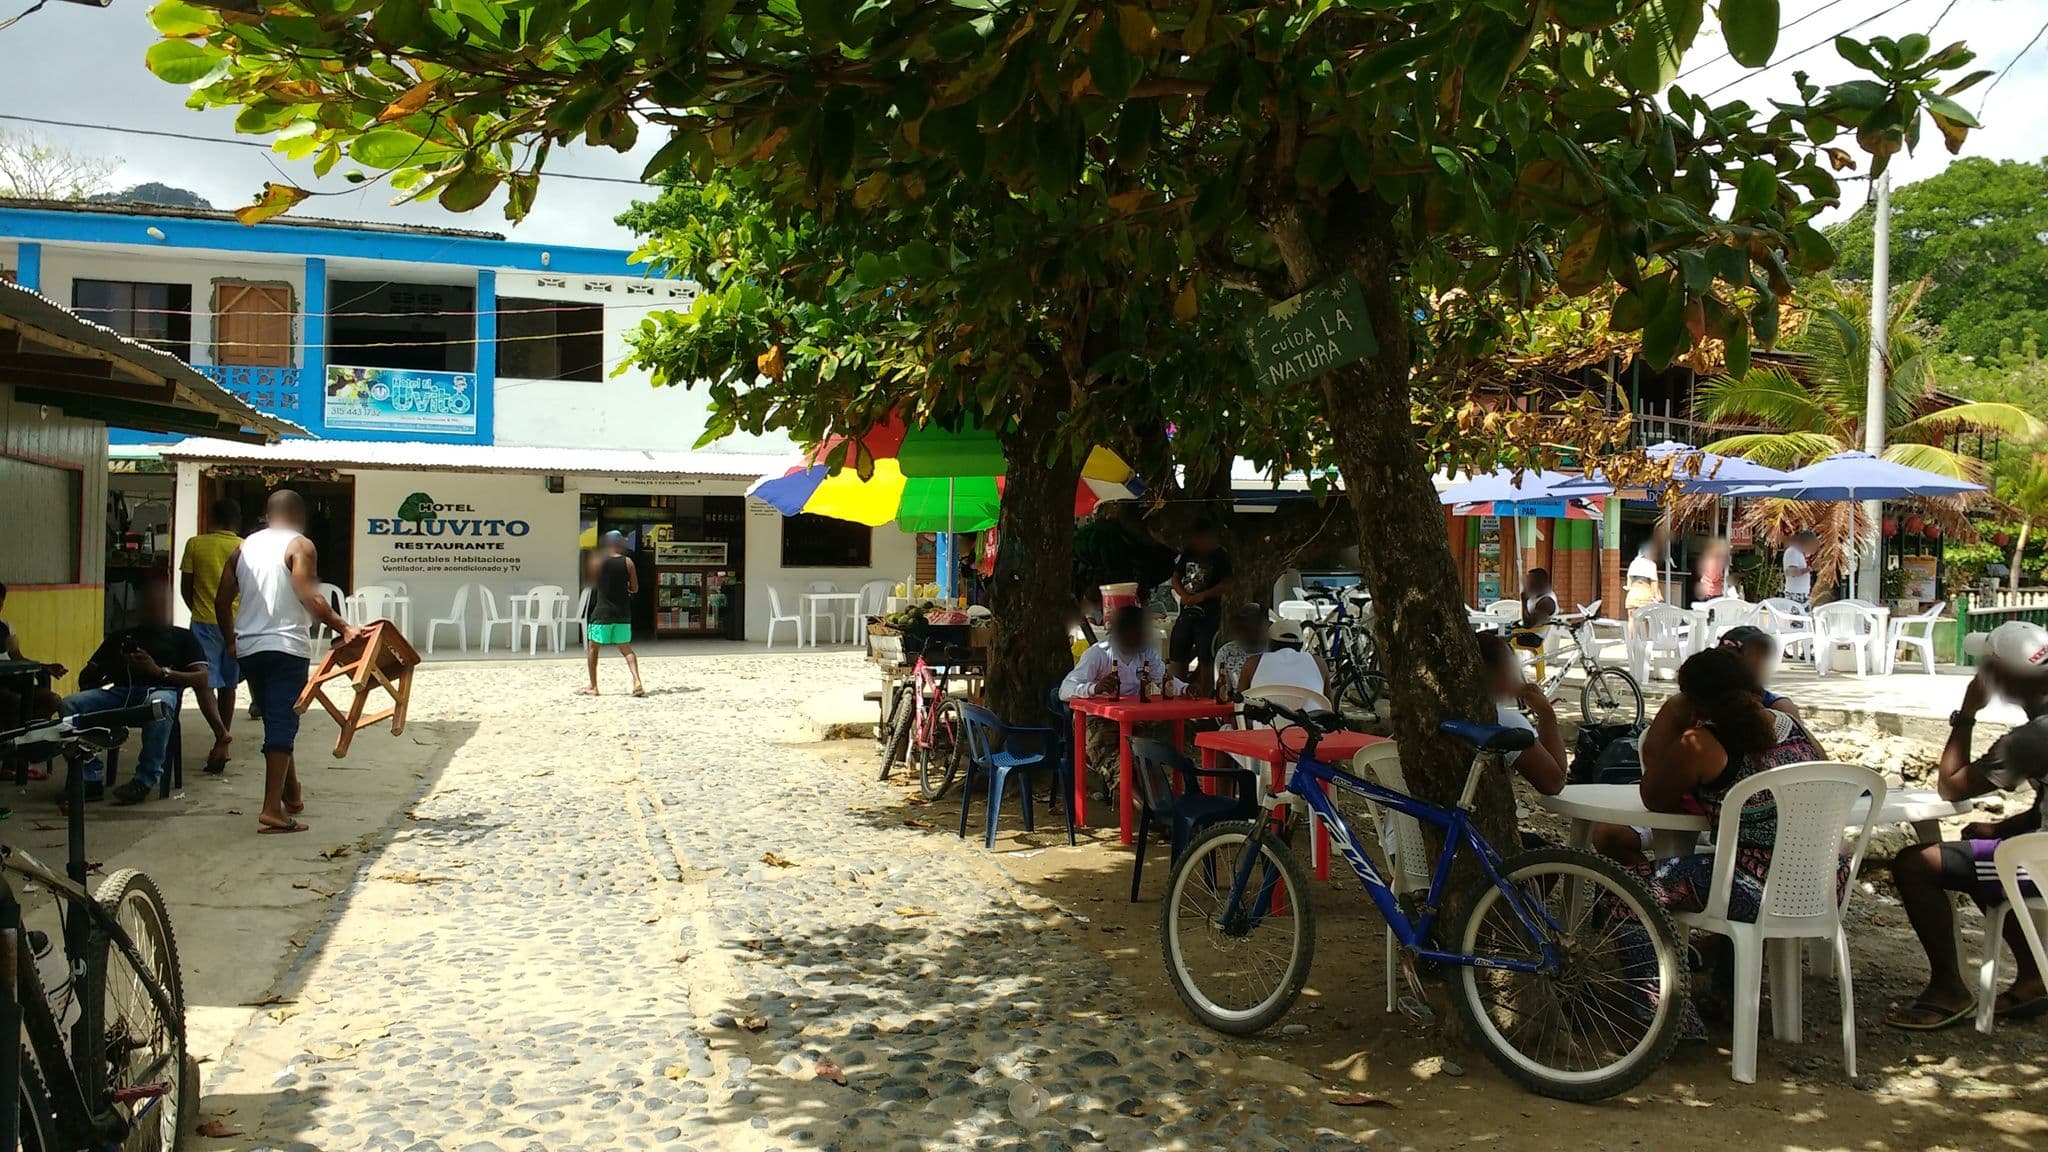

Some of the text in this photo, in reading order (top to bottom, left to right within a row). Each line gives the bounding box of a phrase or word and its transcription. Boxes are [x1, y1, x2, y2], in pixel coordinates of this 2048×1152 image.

[1271, 309, 1353, 355] CUIDA LA
[1268, 339, 1342, 385] NATURA
[392, 385, 471, 414] Uvito
[420, 504, 475, 512] HOTEL
[367, 519, 530, 537] EL UVITO
[394, 542, 505, 550] RESTAURANTE
[382, 555, 521, 563] Confortables Habitaciones
[382, 564, 425, 572] Ventilador,
